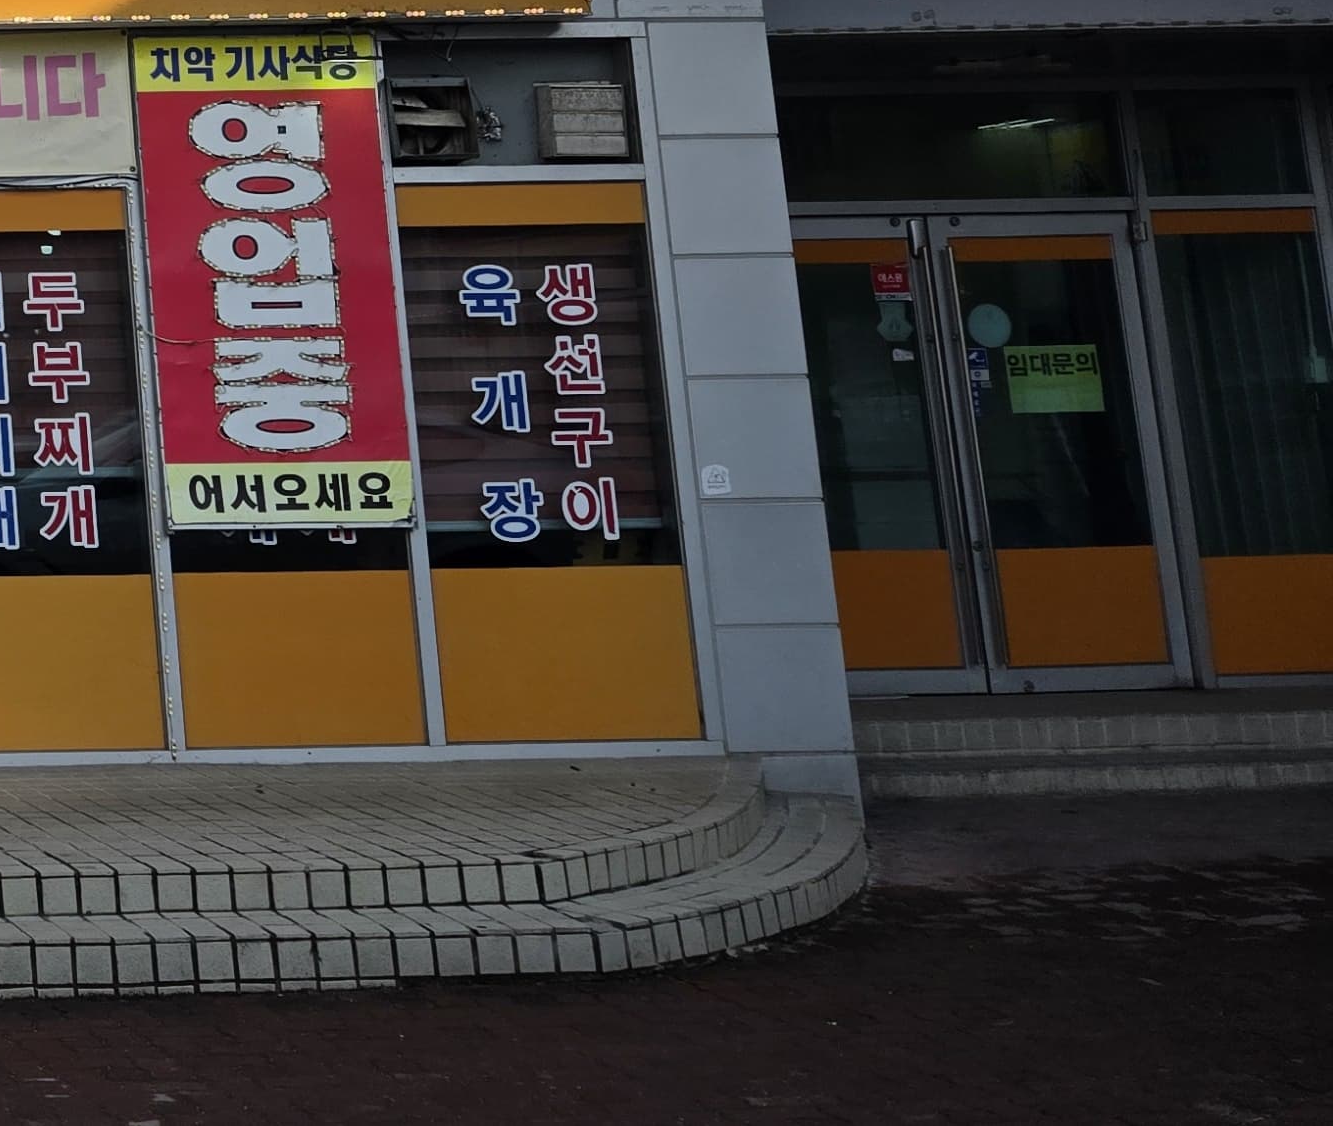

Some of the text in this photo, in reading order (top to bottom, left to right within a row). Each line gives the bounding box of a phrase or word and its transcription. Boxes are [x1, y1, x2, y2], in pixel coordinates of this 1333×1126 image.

[23, 272, 99, 549] 두부찌개
[188, 100, 353, 453] 영업중
[459, 264, 542, 542] 육개장
[537, 264, 620, 541] 생선구이
[1007, 352, 1099, 377] 임대문의
[188, 472, 394, 514] 어서오세요
